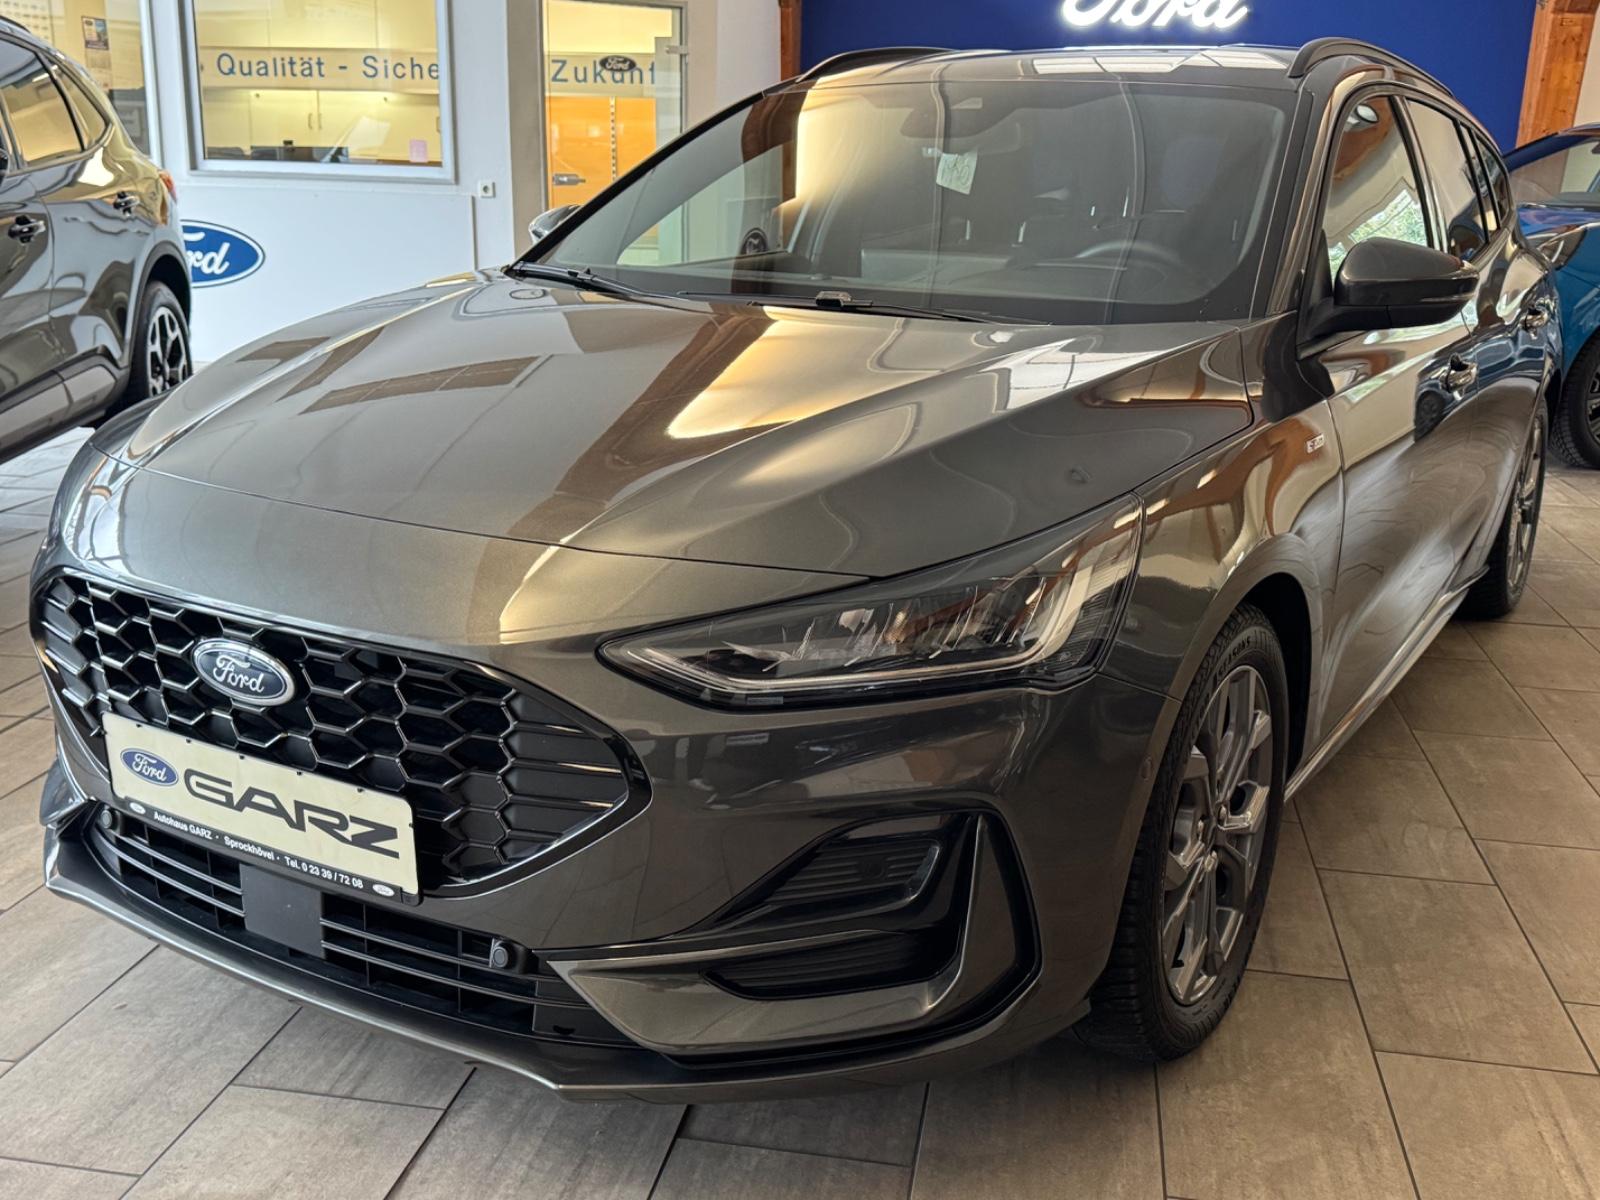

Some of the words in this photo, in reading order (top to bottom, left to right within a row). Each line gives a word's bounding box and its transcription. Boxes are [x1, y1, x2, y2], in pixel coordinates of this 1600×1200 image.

[217, 52, 325, 78] Qualität
[183, 231, 230, 275] rd
[213, 654, 265, 693] Ford
[132, 753, 167, 781] Ford
[184, 768, 399, 860] GARZ
[154, 811, 188, 832] Autohaus
[189, 824, 213, 839] GARZ
[223, 835, 274, 861] Sprockhövel
[301, 862, 308, 872] 0
[309, 865, 320, 876] 23
[321, 868, 333, 880] 39
[339, 874, 351, 886] 72
